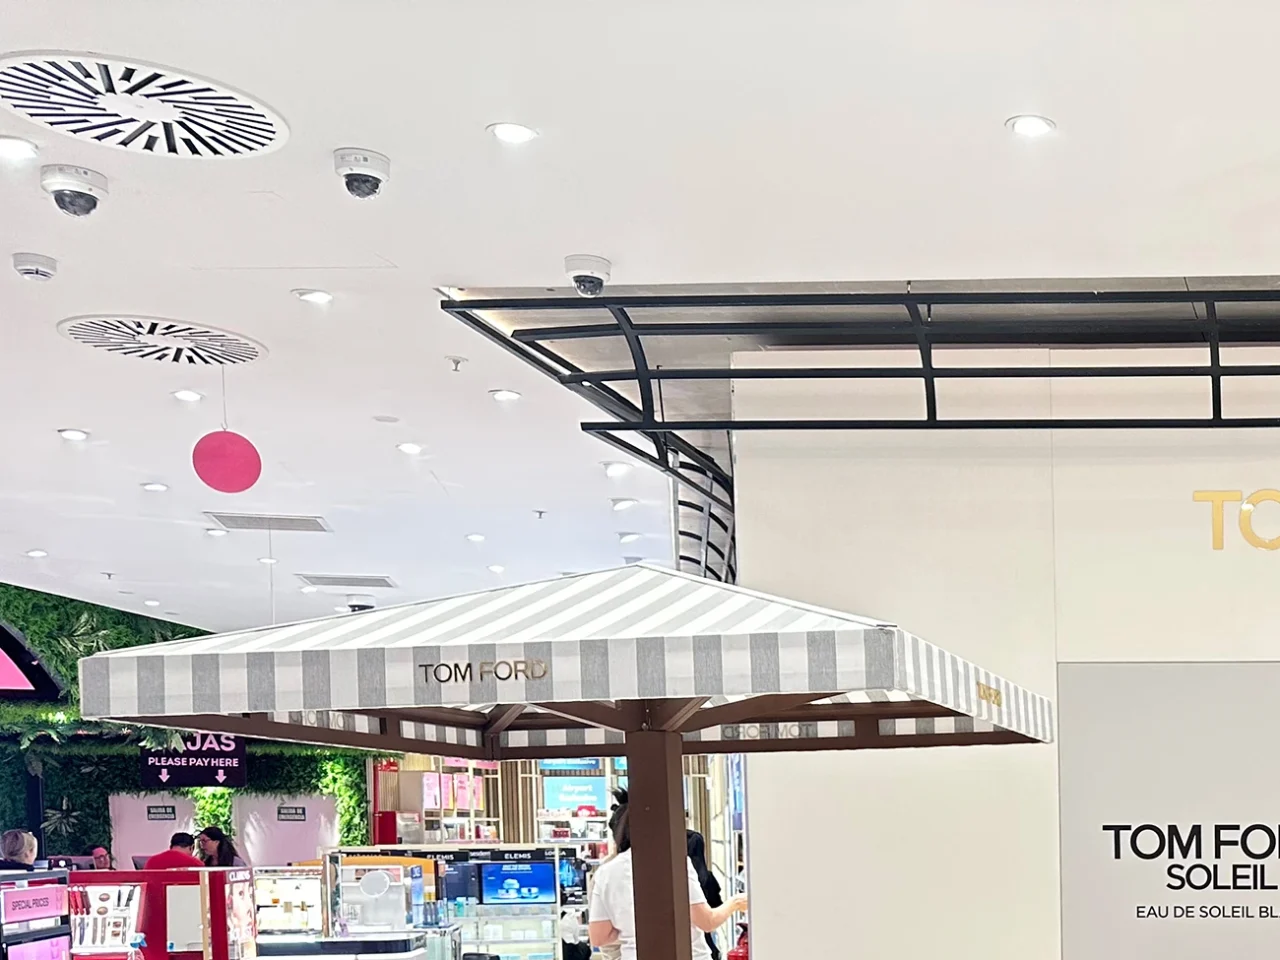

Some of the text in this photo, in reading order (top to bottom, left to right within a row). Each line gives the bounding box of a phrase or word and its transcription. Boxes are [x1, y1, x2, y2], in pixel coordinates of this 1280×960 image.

[418, 659, 548, 683] TOM FORD
[148, 757, 239, 767] PLEASE PAY HERE
[1102, 824, 1201, 860] TOM
[1166, 863, 1279, 890] SOLEIL
[1136, 905, 1169, 919] EAU
[1173, 905, 1195, 919] DE
[1199, 905, 1255, 919] SOLEIL
